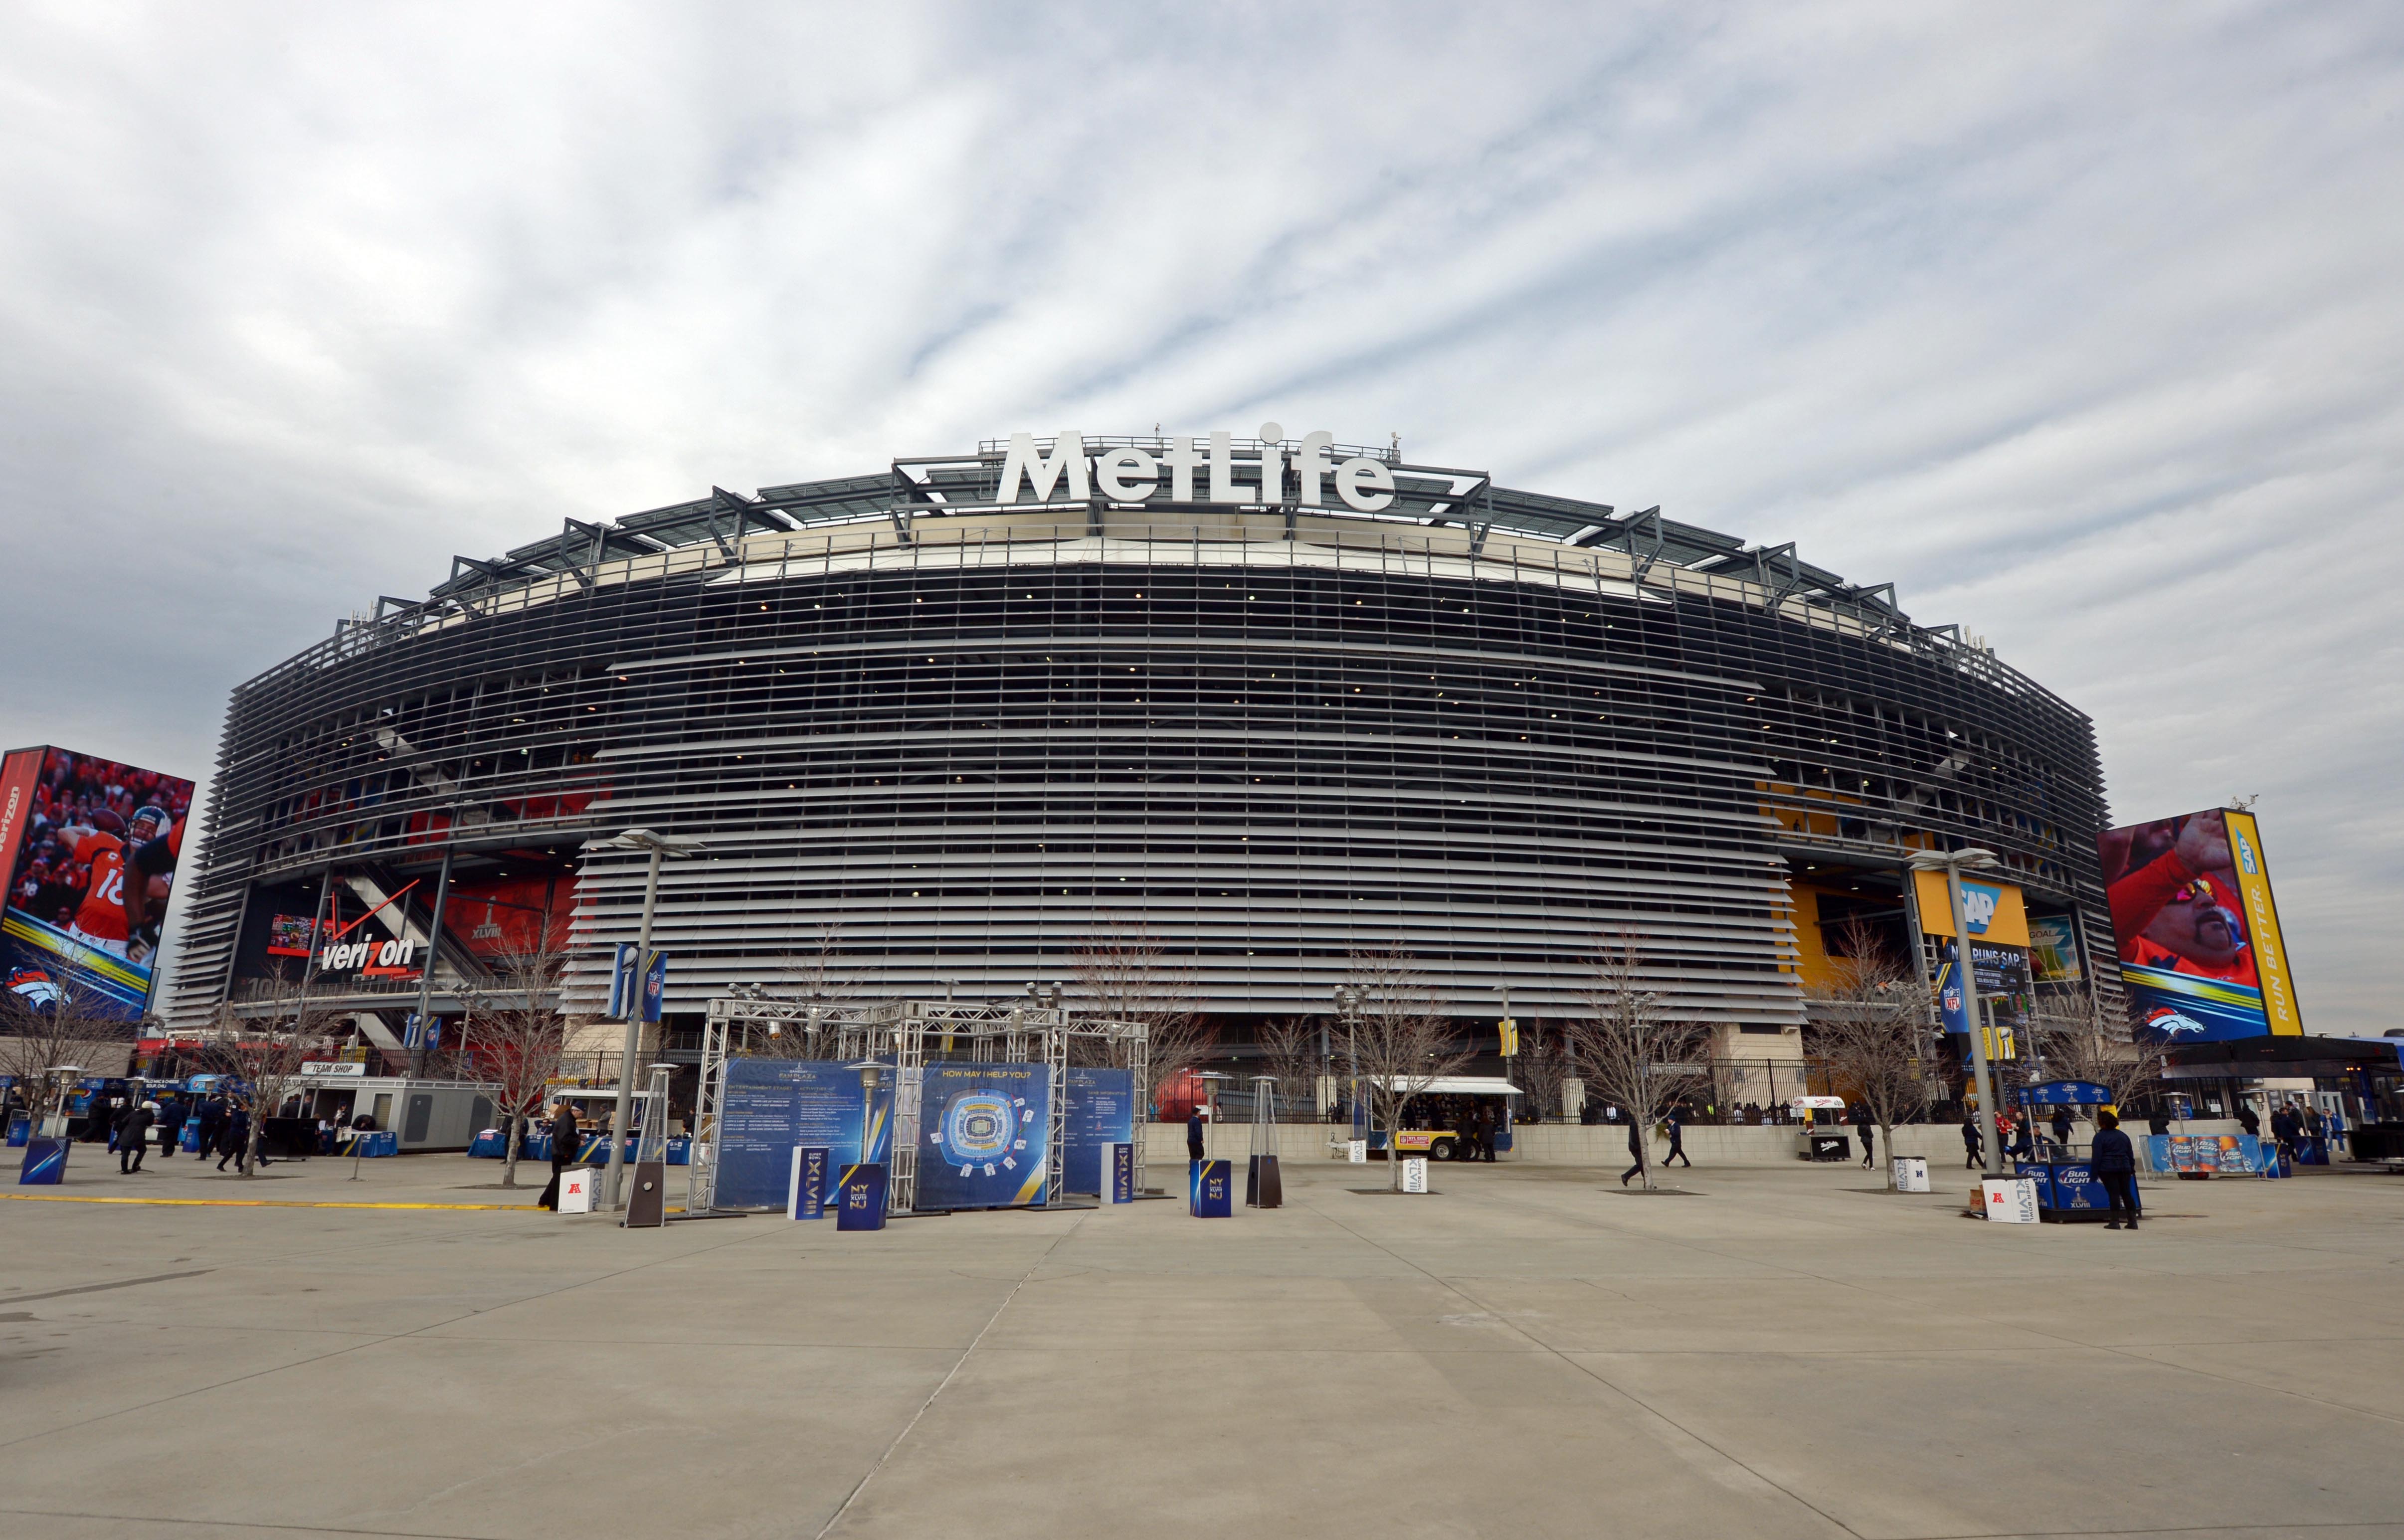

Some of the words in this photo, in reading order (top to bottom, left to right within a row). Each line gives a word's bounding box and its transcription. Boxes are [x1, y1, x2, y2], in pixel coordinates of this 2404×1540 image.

[995, 421, 1395, 512] MetLife
[2239, 838, 2256, 873] SAP
[96, 868, 124, 905] 18
[471, 927, 502, 939] XLVIII
[2251, 884, 2277, 970] BETTER.
[322, 933, 415, 975] verizon
[1972, 948, 1999, 965] RUNS
[2001, 951, 2022, 967] SAP.
[649, 983, 659, 994] NFL
[1946, 999, 1960, 1010] NFL
[2270, 975, 2289, 1022] RUN
[803, 1161, 821, 1214] XLVIII
[851, 1185, 869, 1194] NY
[1118, 1154, 1128, 1199] XLVIII
[1409, 1159, 1418, 1191] XLVIII
[850, 1200, 867, 1210] NJ
[2016, 1179, 2031, 1221] XLVIII
